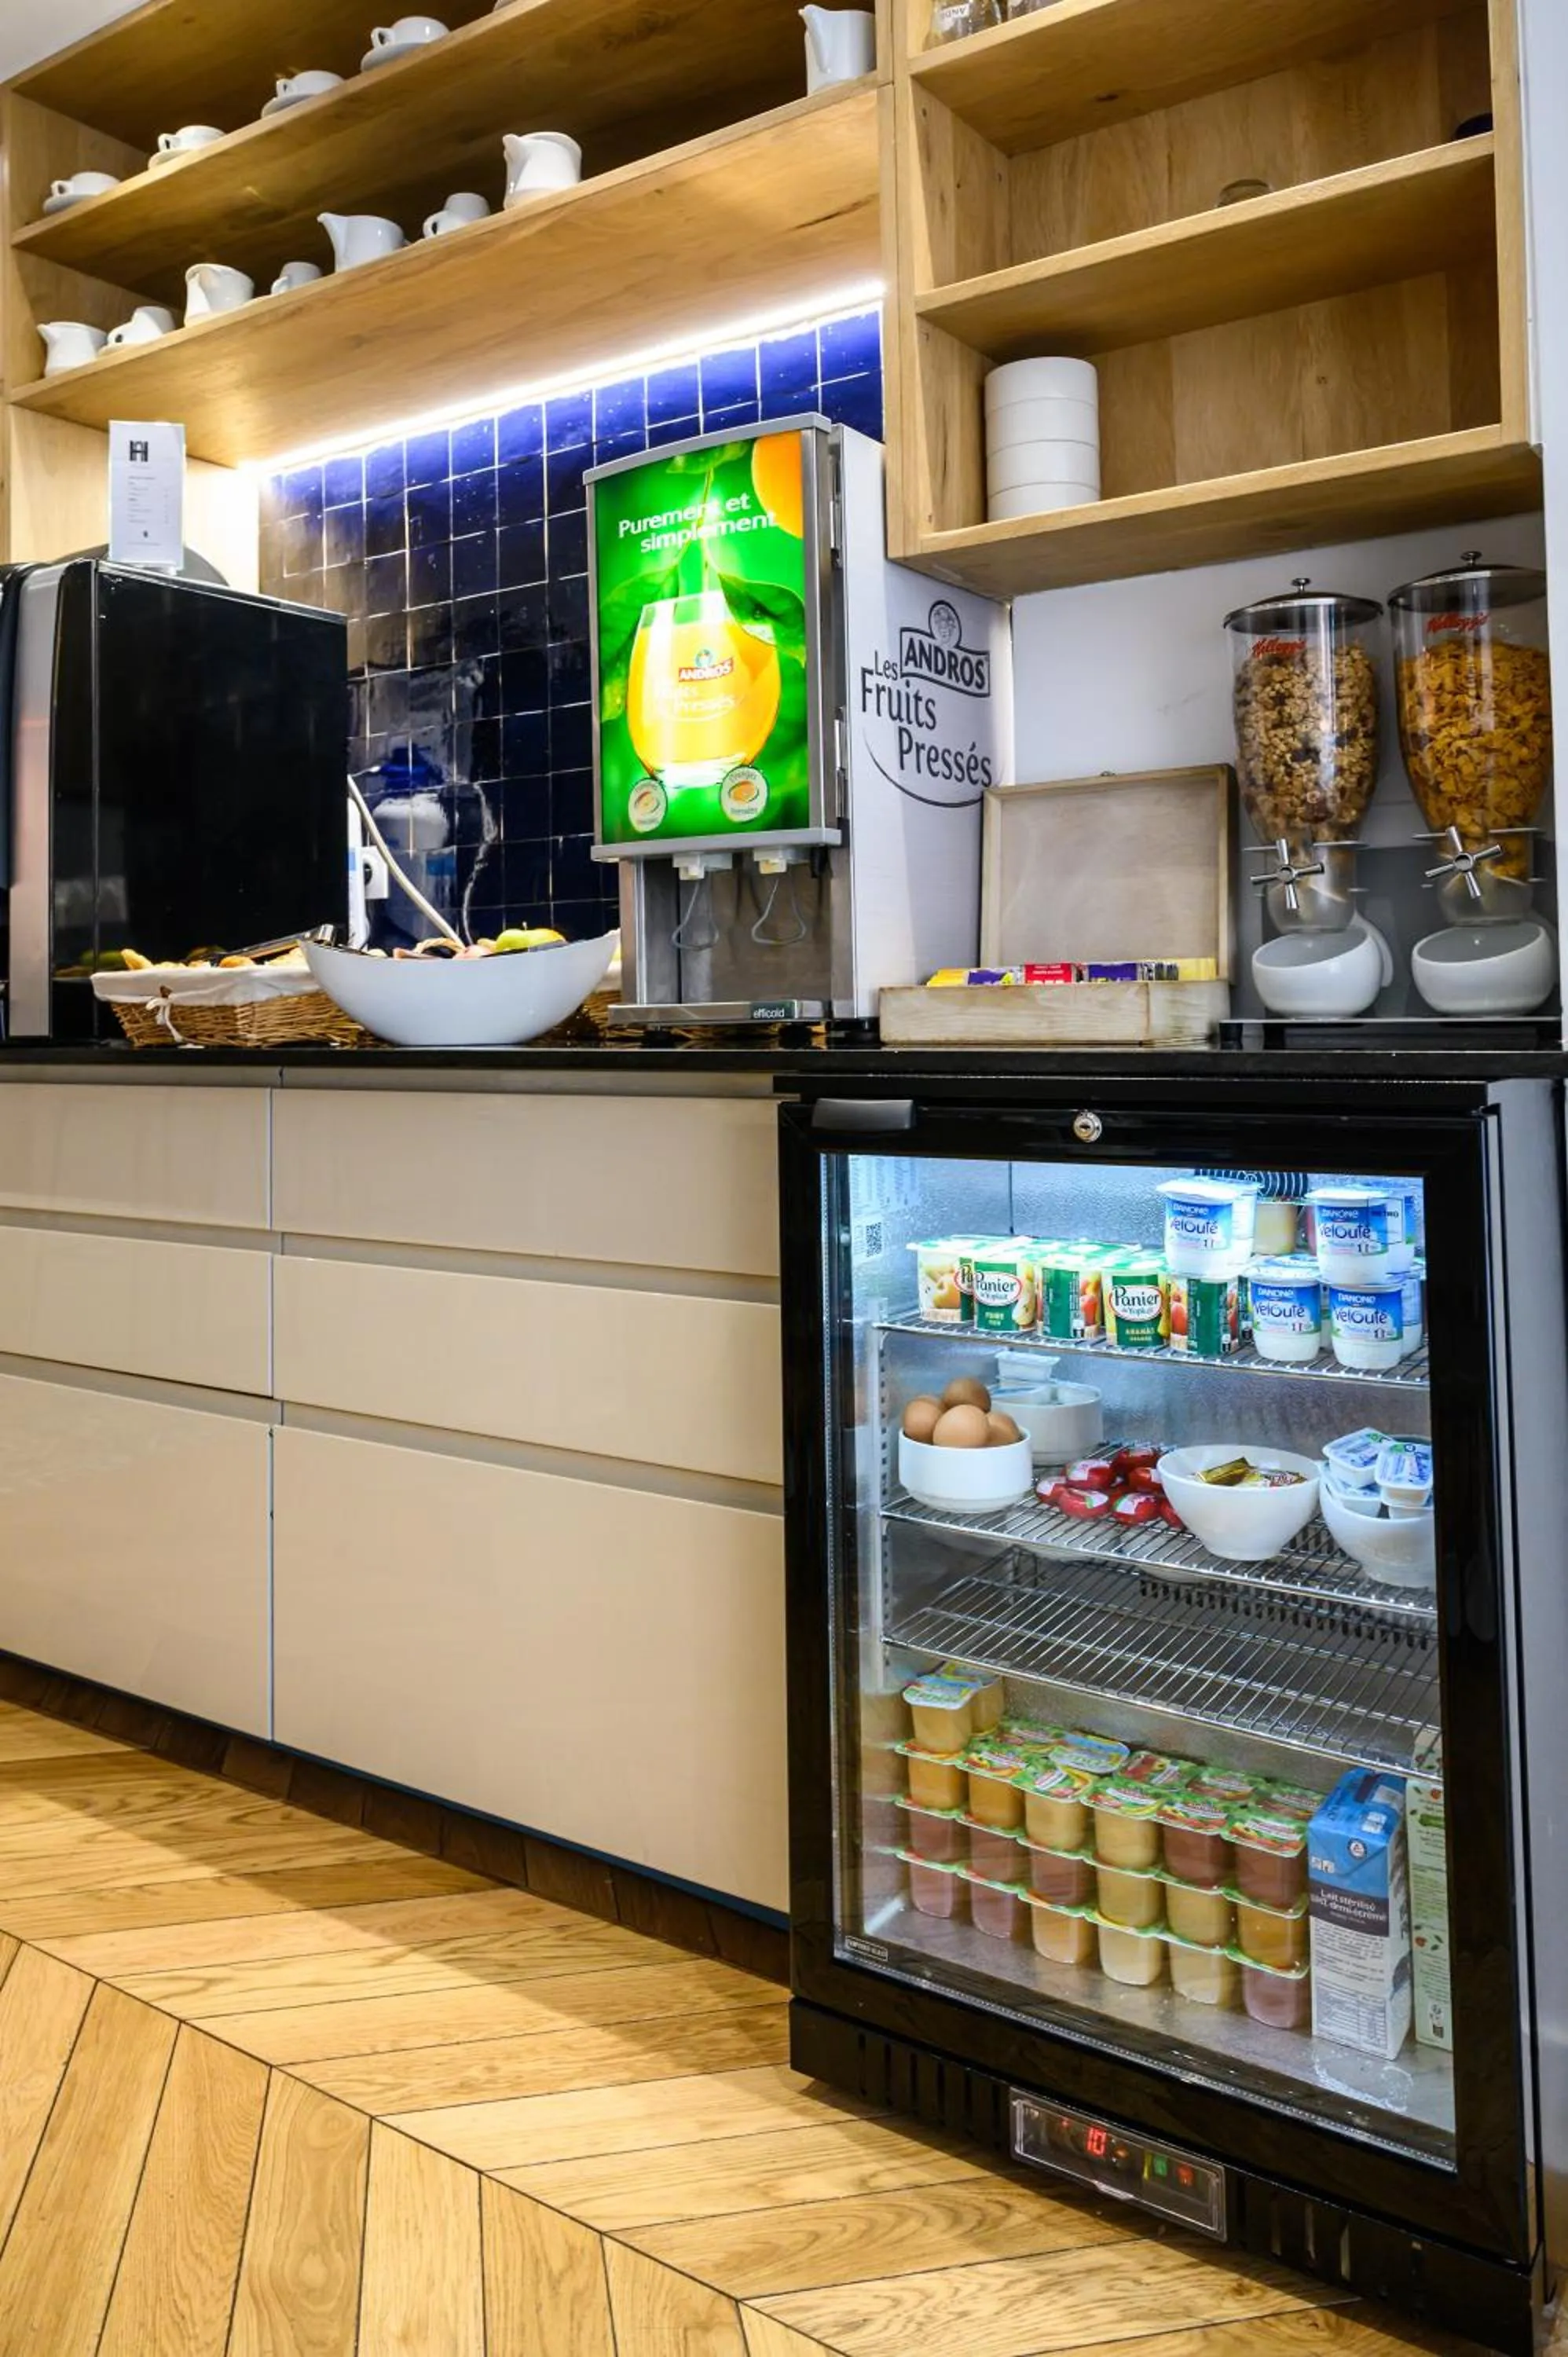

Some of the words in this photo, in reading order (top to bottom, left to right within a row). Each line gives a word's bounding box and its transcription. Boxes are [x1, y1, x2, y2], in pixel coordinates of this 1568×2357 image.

[618, 499, 720, 538] Purement
[725, 493, 751, 511] et
[640, 511, 778, 553] simplement
[874, 650, 899, 681] Les
[904, 637, 986, 690] ANDROS
[861, 666, 936, 730] Fruits
[898, 725, 992, 788] Pressés
[1112, 1286, 1160, 1306] Panier
